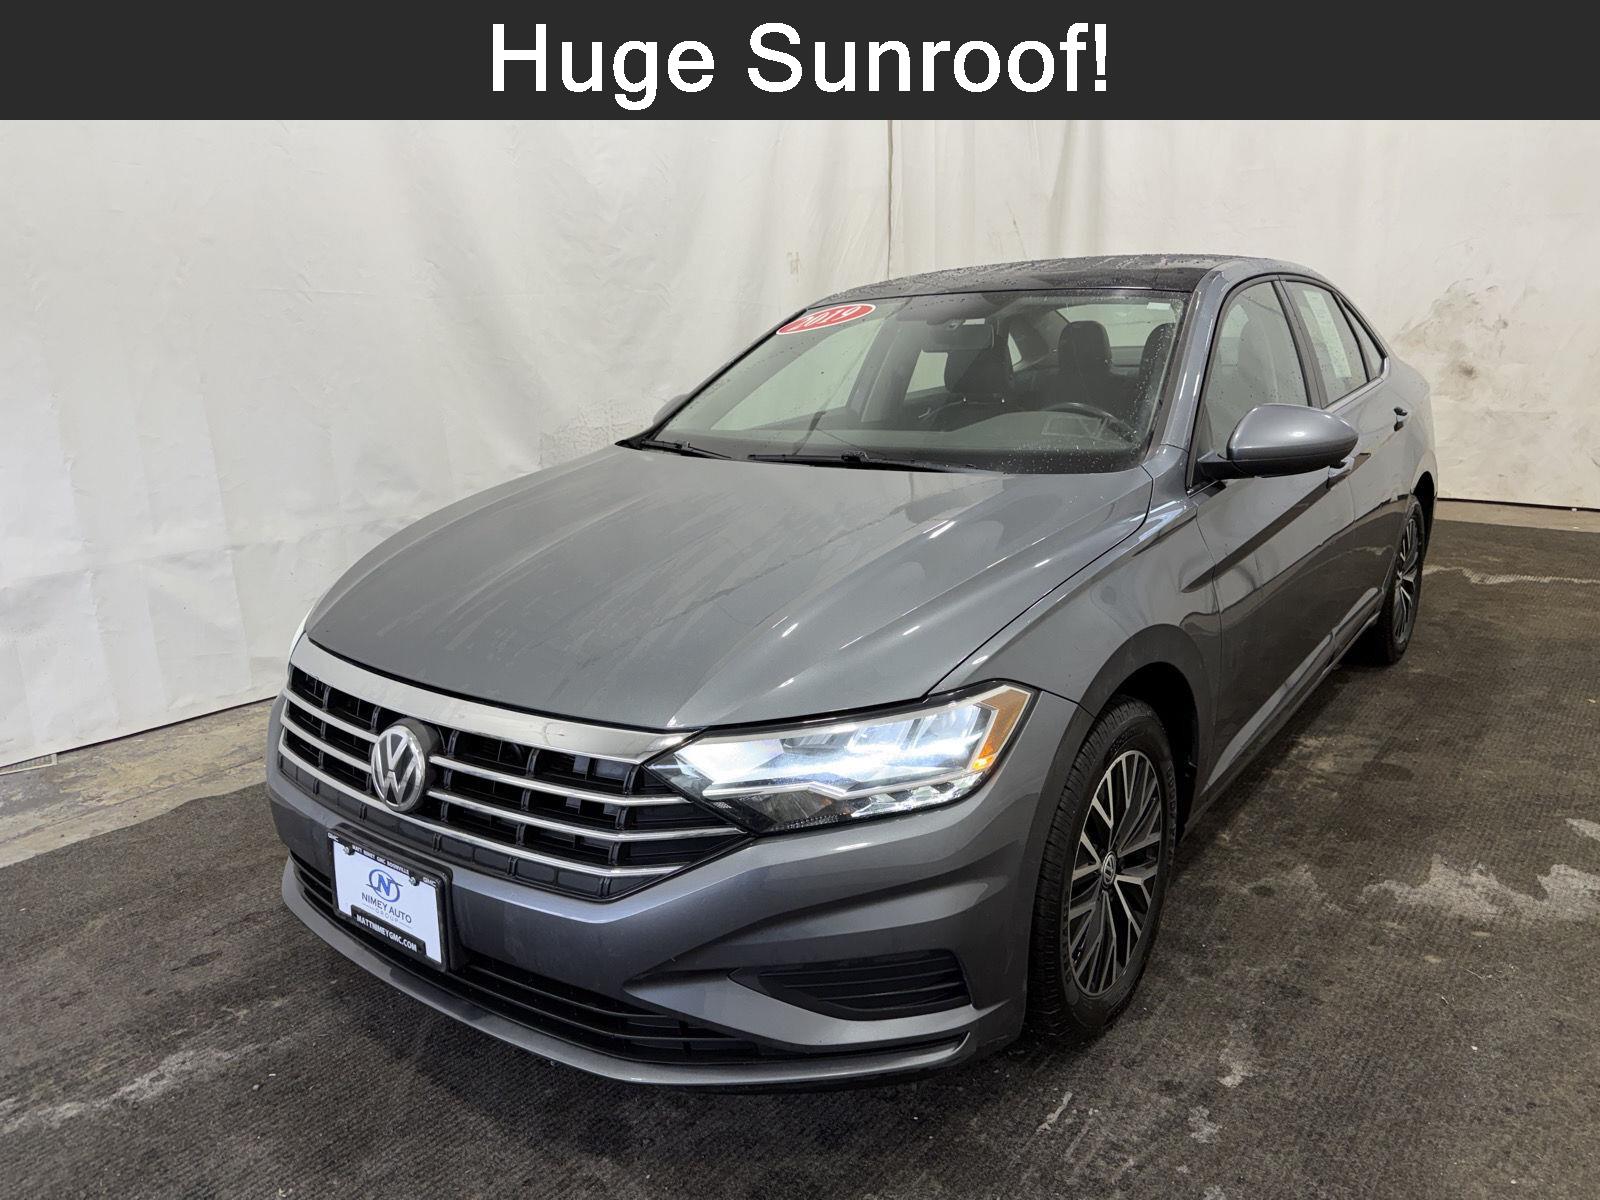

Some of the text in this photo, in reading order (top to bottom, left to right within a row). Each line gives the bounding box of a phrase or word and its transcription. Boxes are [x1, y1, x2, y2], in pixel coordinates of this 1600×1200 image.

[785, 304, 862, 332] 2019
[361, 892, 412, 923] NIMEY AUTO
